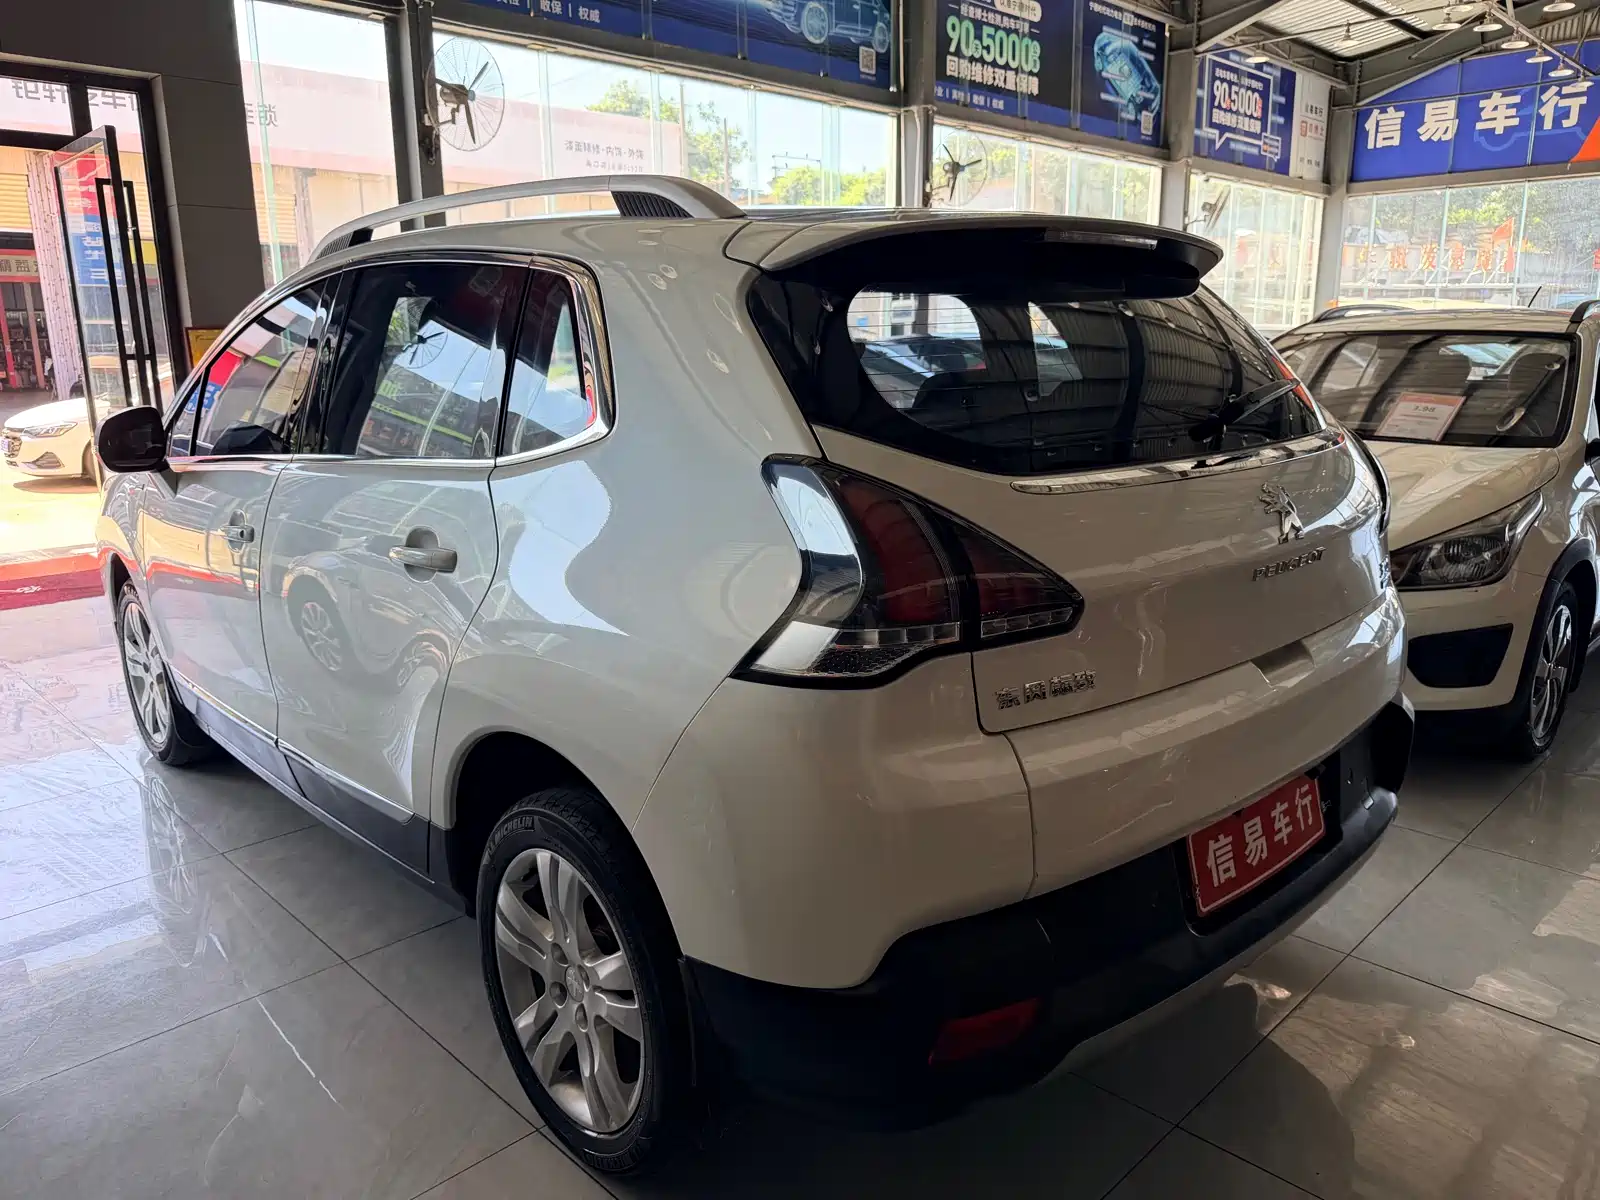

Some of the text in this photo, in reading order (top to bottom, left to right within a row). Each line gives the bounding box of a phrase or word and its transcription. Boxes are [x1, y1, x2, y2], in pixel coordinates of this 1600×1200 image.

[578, 6, 600, 23] 权威
[946, 54, 1039, 96] 回购维修双重保障
[1365, 84, 1589, 150] 信易车行
[1252, 547, 1326, 582] PEUGEOT
[993, 669, 1096, 710] 东风标致
[494, 815, 533, 845] MICHELIN
[1206, 783, 1314, 888] 信易车行
